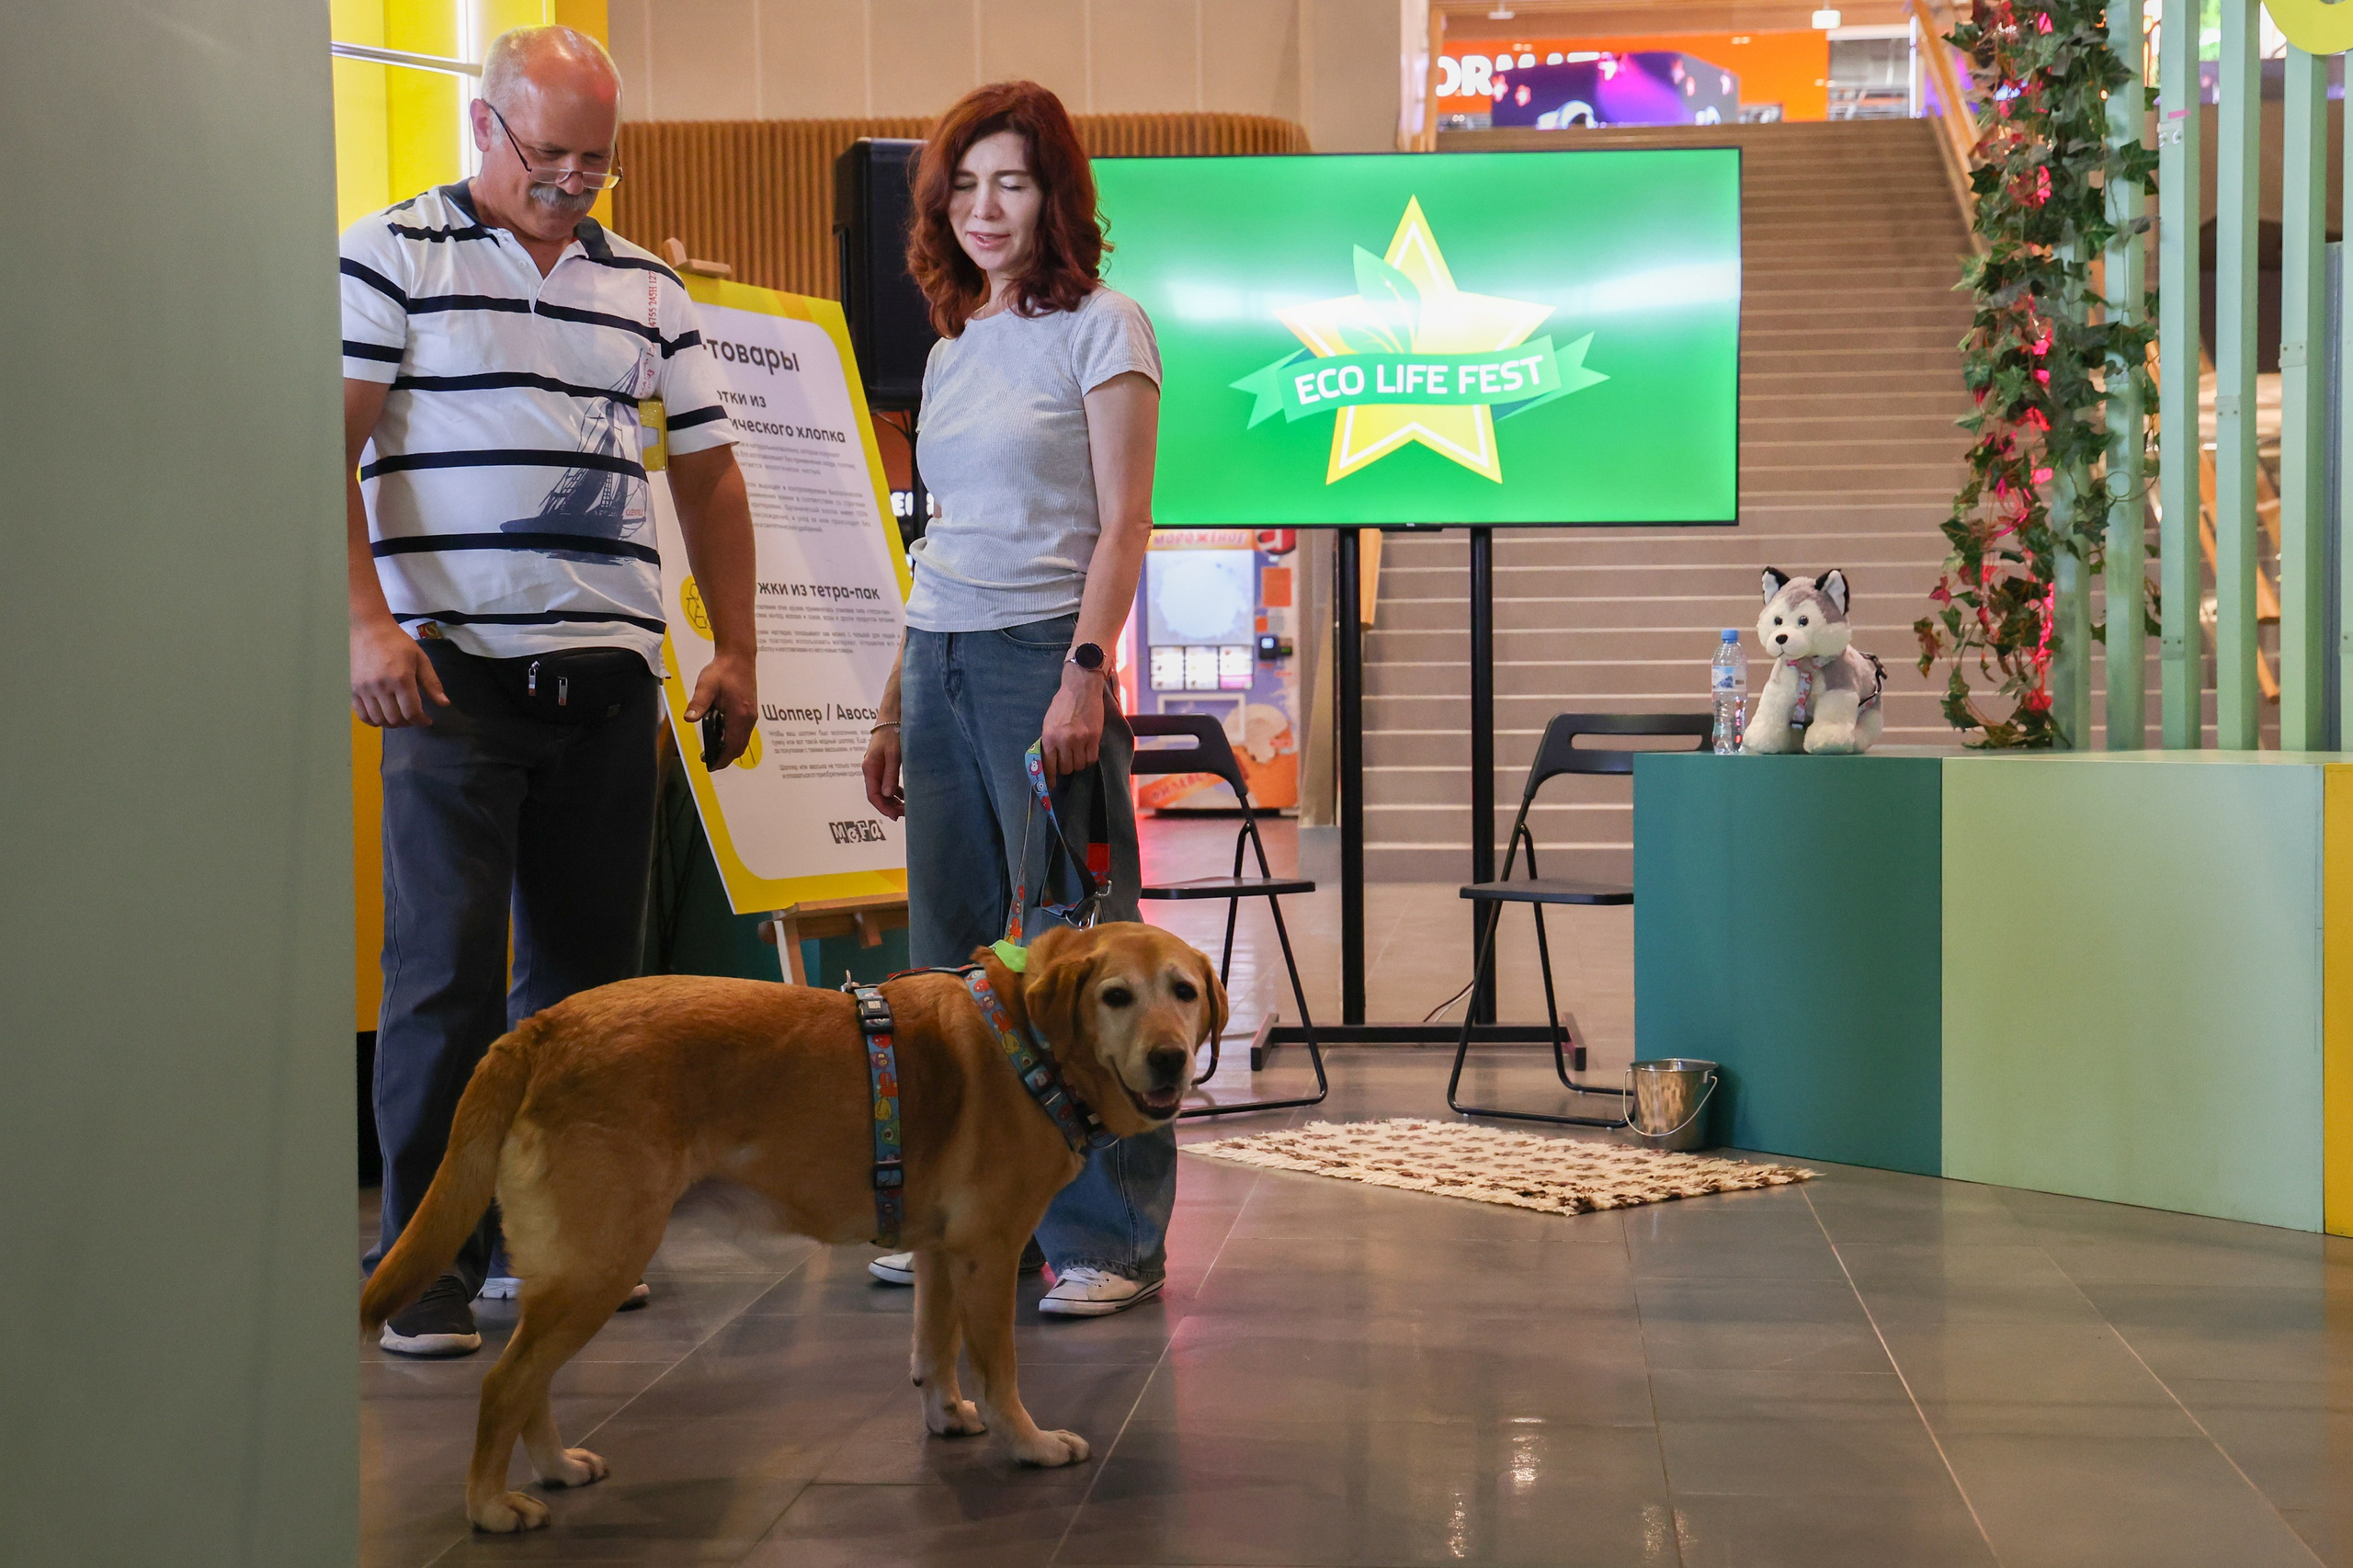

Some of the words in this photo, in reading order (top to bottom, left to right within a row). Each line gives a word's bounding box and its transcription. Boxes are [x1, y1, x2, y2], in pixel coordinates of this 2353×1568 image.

[1294, 365, 1365, 405] ECO
[1377, 364, 1449, 394] LIFE
[1459, 355, 1543, 394] FEST
[750, 394, 767, 408] из
[796, 426, 846, 443] хлопка
[790, 584, 807, 597] из
[809, 585, 881, 602] тетра-пак
[761, 704, 822, 724] Шоппер
[826, 703, 831, 722] /
